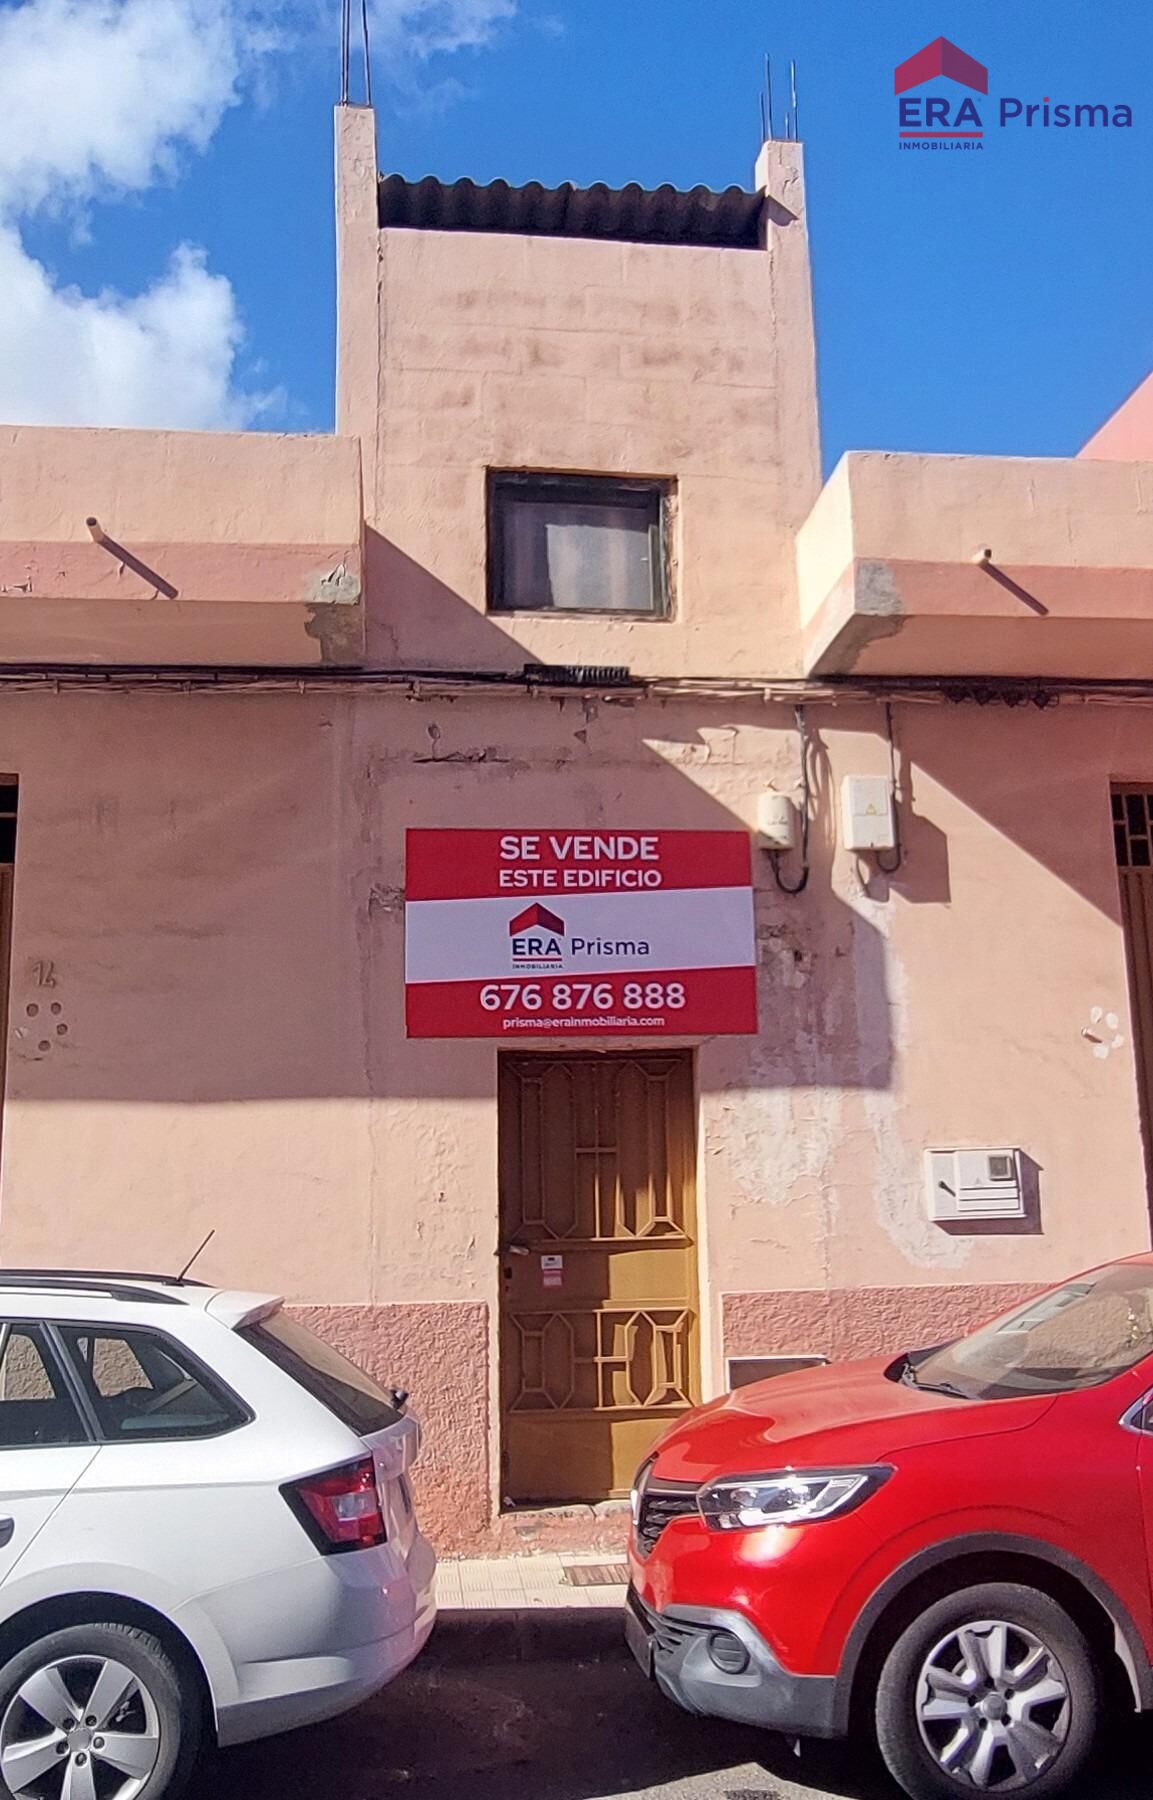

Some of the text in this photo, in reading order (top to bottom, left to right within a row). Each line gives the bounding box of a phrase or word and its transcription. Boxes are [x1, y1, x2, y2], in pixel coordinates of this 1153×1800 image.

[500, 836, 659, 860] SE VENDE
[499, 869, 662, 887] ESTE EDIFICIO
[512, 937, 650, 955] ERA Prisma
[480, 983, 685, 1010] 676 876 888
[502, 1016, 665, 1029] prisma@erainmobiliaria.com
